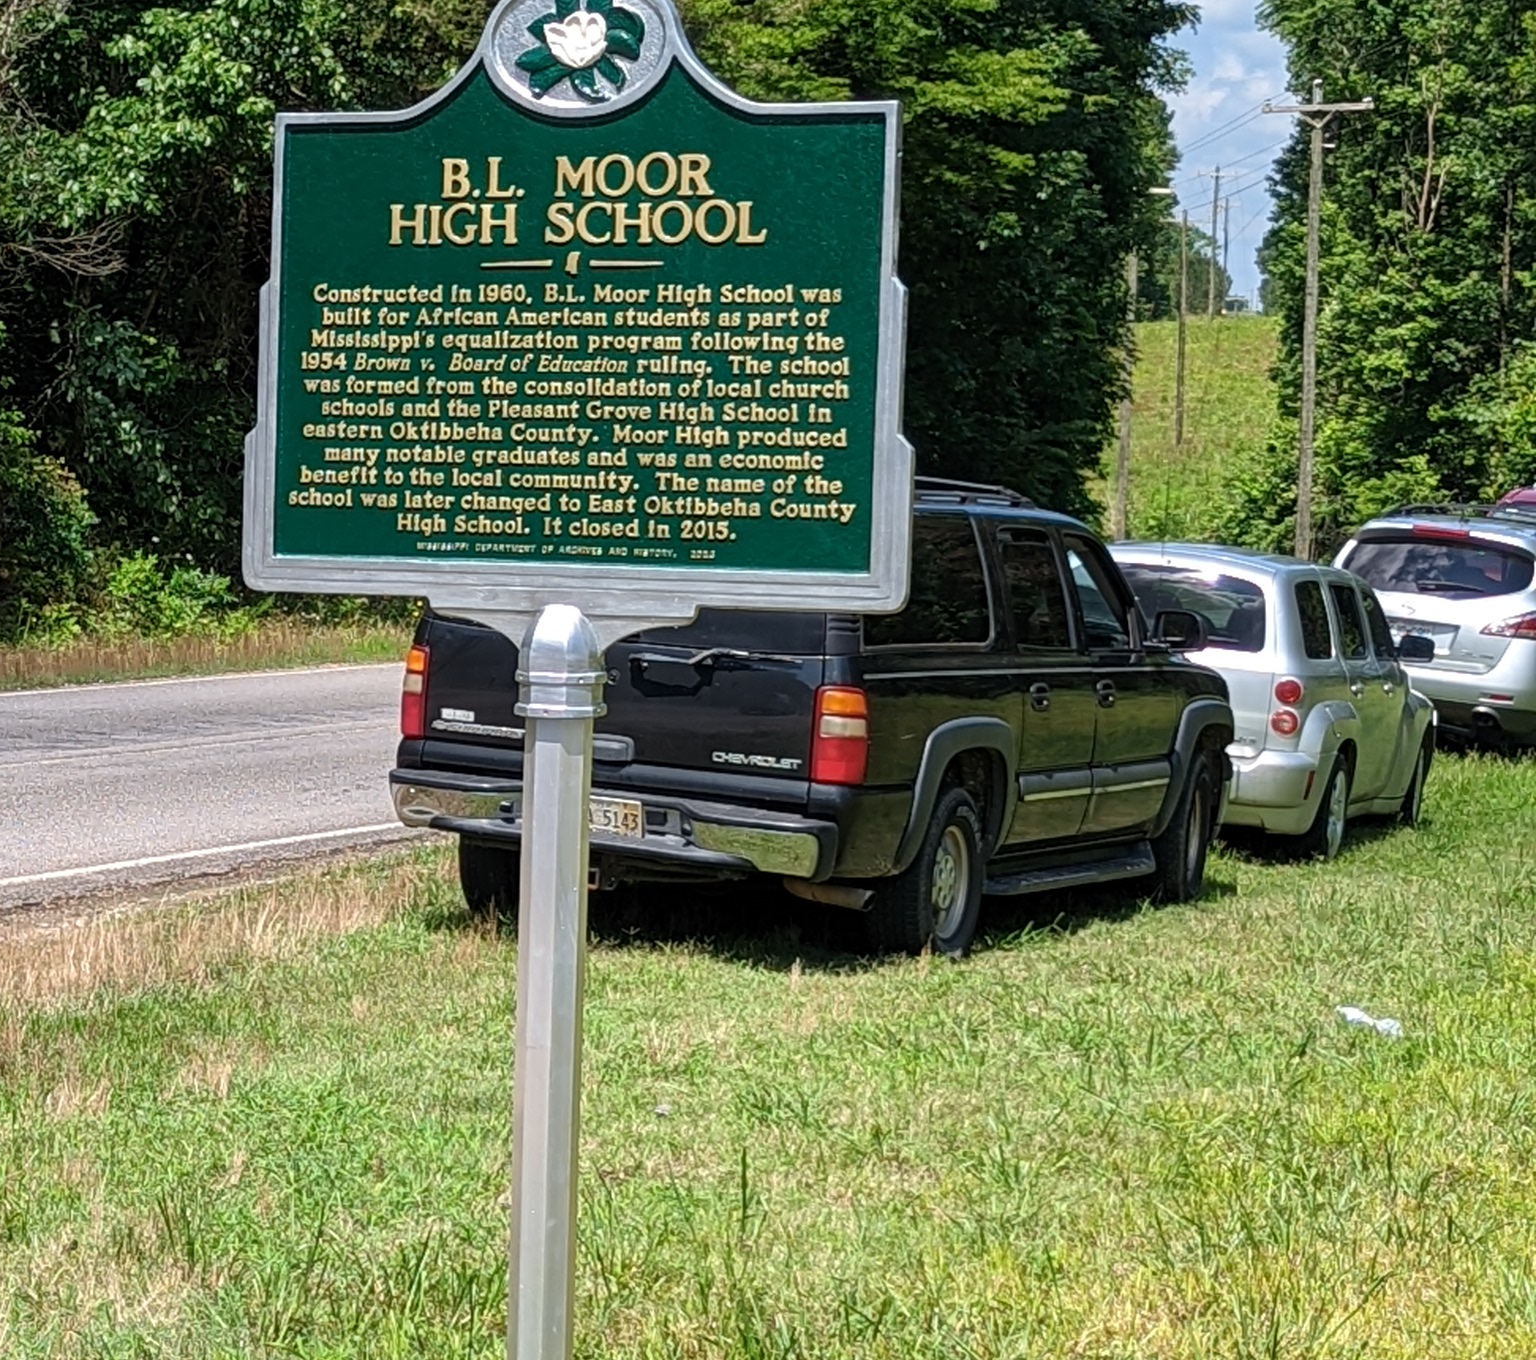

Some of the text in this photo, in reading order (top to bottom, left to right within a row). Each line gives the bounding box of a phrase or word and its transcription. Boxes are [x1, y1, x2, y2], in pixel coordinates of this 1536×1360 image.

[440, 151, 715, 199] B.L. MOOR
[388, 198, 768, 245] HIGH SCHOOL
[313, 282, 842, 308] Constructed in 1960, B.L. Moor High School was
[321, 306, 831, 332] built for African American students as part of
[310, 328, 845, 355] Mississippi's equalization program following the
[301, 351, 850, 379] 1954 Brown v. Board of Education ruling. The school
[303, 374, 850, 399] was formed from the consolidation of local church
[321, 397, 833, 425] schools and the Pleasant Grove High School in
[302, 420, 848, 450] eastern Oktibbeha County. Moor High produced
[324, 444, 824, 471] many notable graduates and was an economic
[299, 464, 843, 495] benefit to the local community. The name of the
[288, 487, 857, 523] school was later changed to East Oktibbeha County
[397, 512, 737, 540] High School. It closed in 2015.
[712, 750, 802, 770] CHEVROLET
